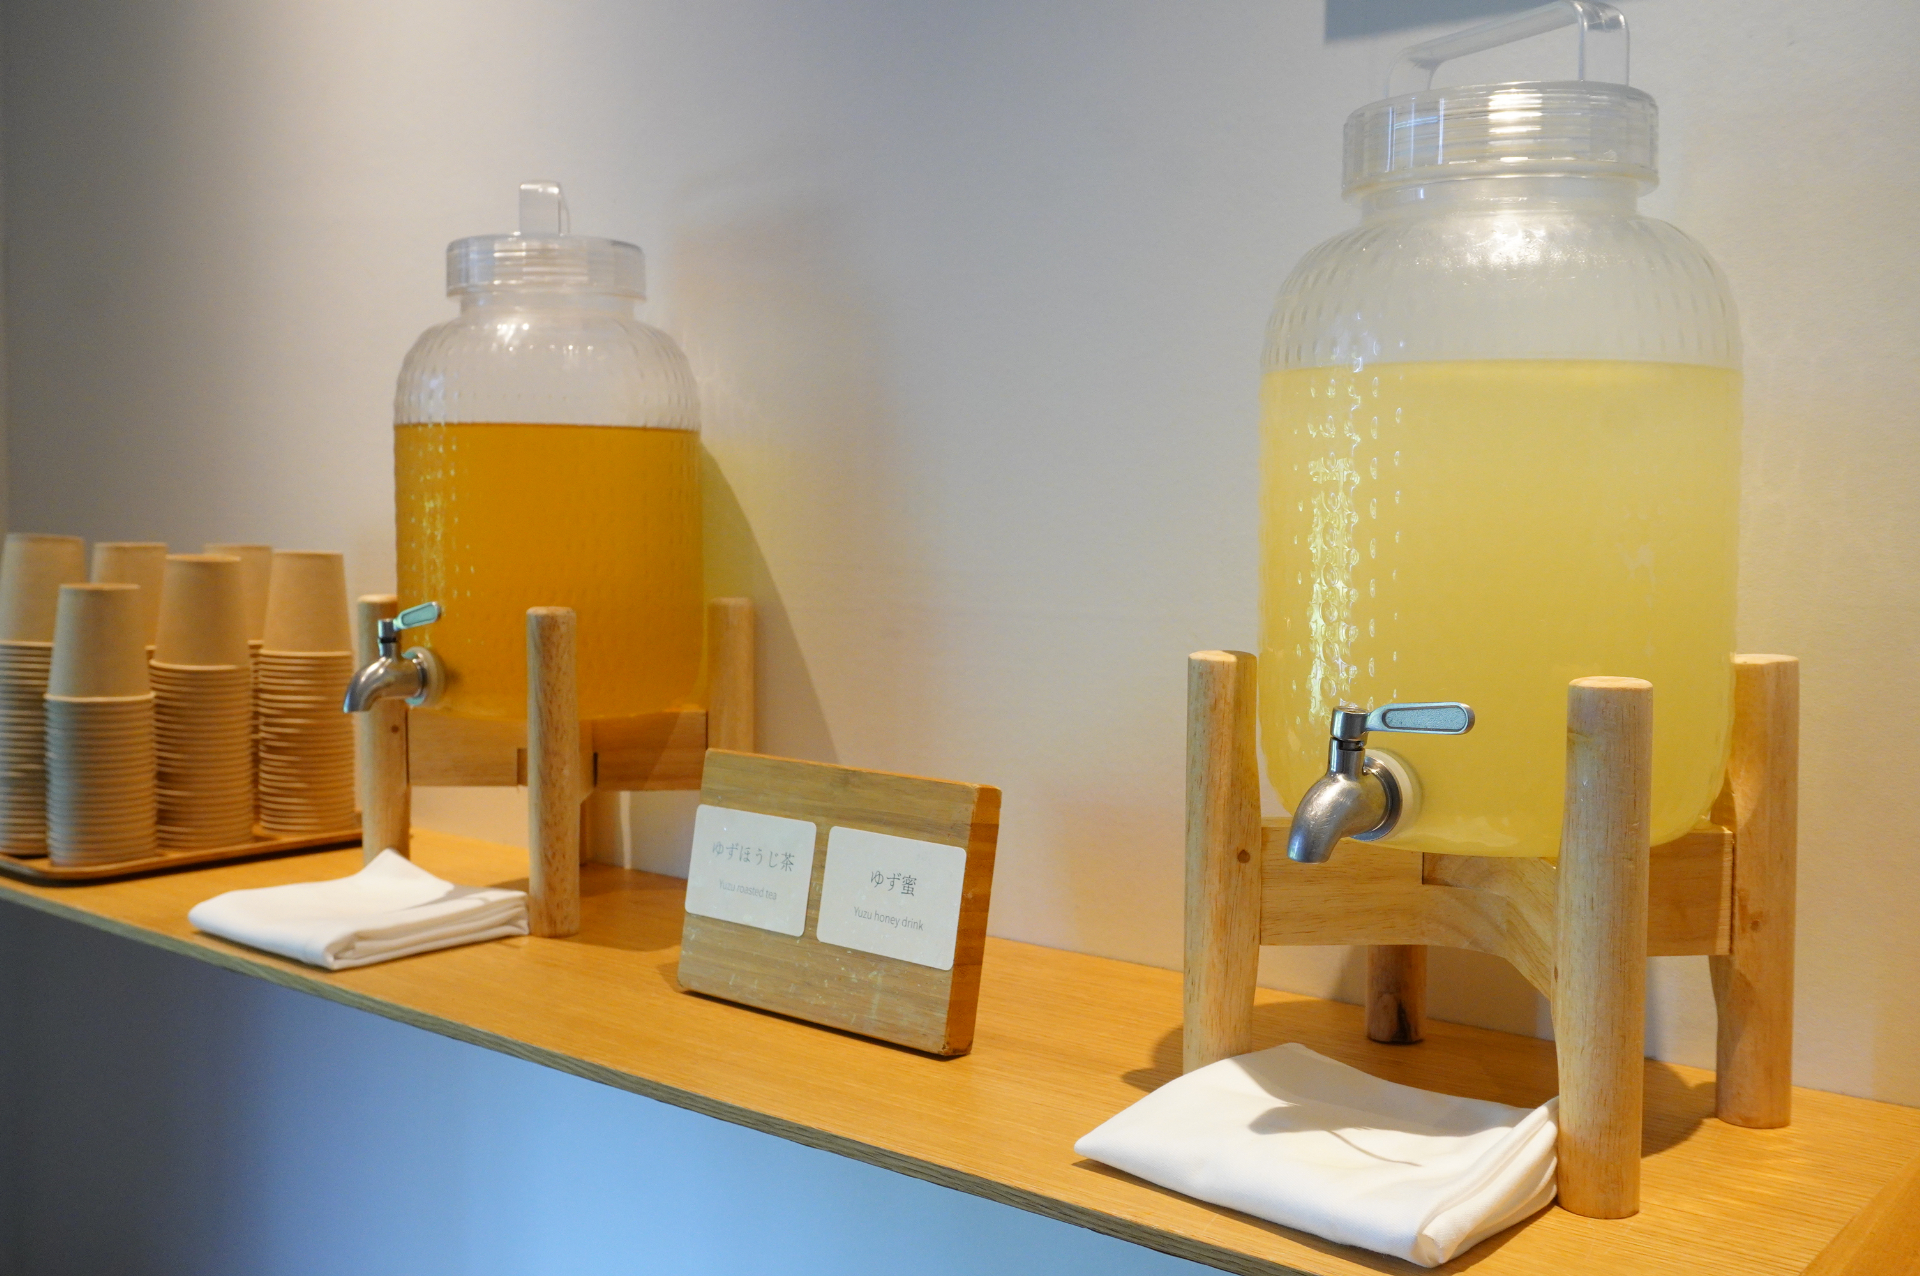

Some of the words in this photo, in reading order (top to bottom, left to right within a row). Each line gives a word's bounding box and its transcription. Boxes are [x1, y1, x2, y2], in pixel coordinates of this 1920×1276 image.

[712, 841, 795, 872] ゆずほうじ茶
[719, 879, 735, 892] Yuzu
[736, 885, 764, 898] roasted
[765, 889, 777, 900] tea
[870, 870, 917, 896] ゆず蜜
[853, 906, 873, 920] Yuzu
[874, 910, 900, 928] honey
[901, 917, 924, 931] drink
